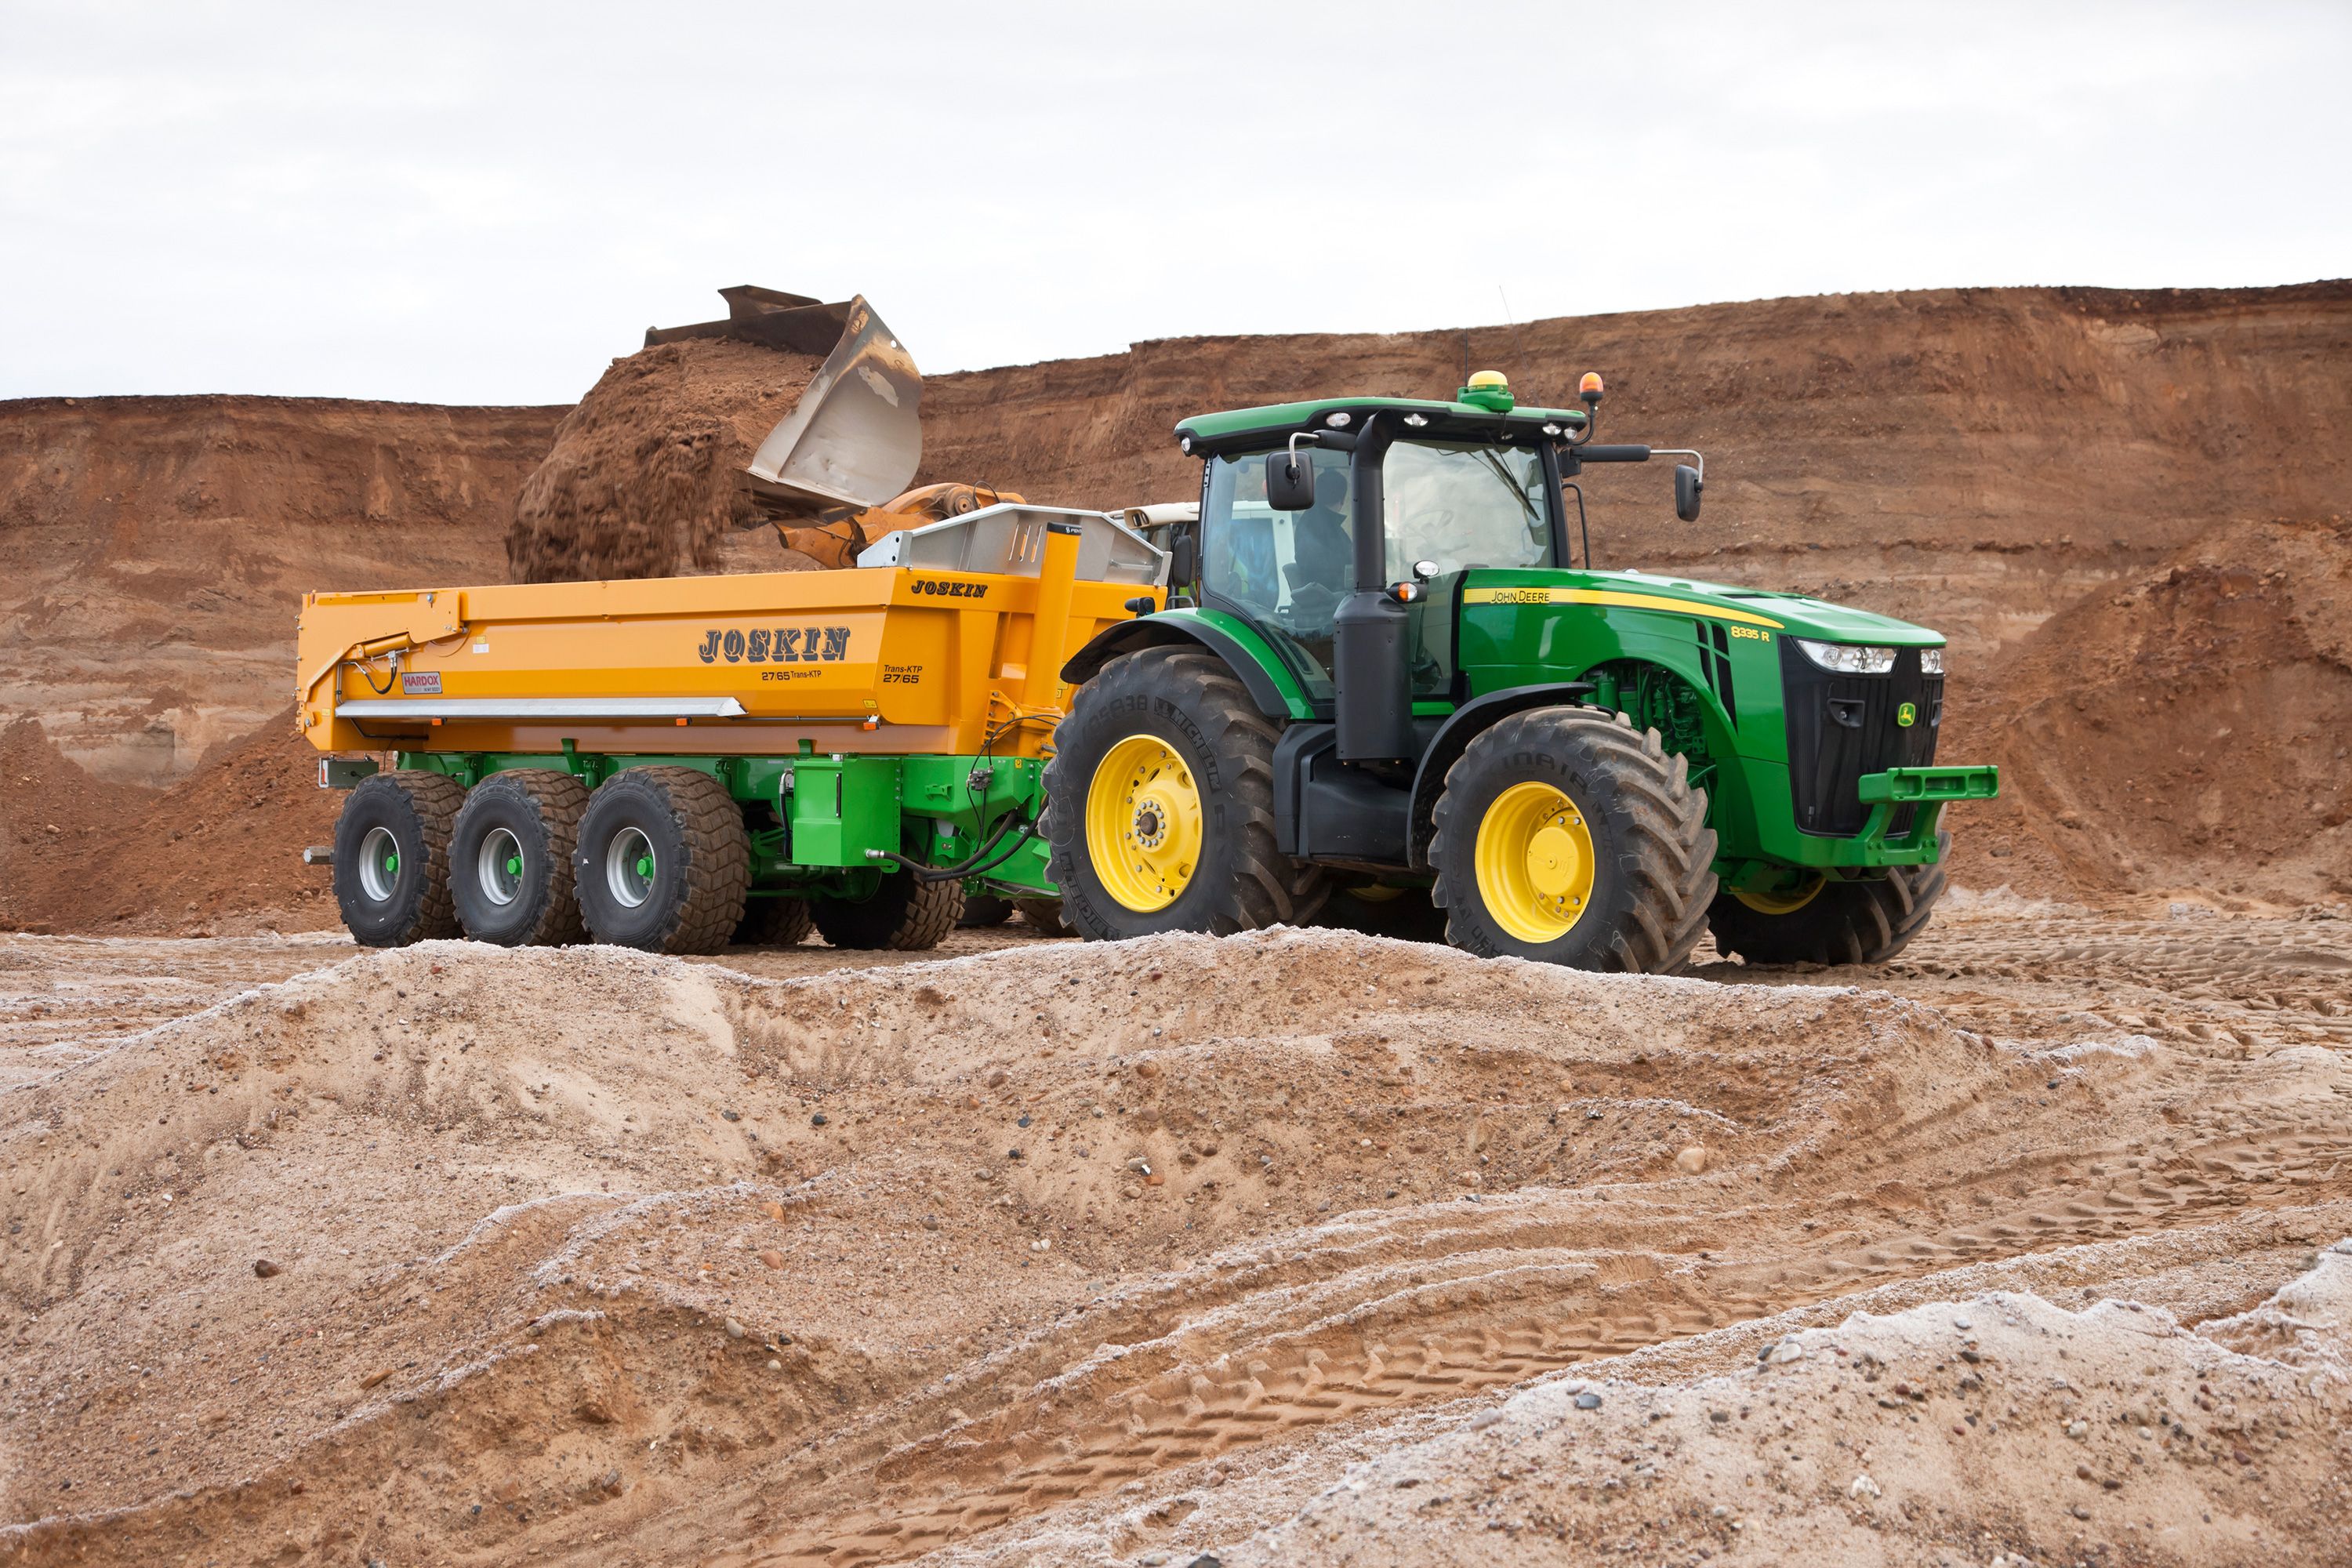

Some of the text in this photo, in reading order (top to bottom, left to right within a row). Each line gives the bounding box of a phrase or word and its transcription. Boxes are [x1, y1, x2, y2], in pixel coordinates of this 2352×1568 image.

[911, 580, 988, 598] JOSKIN
[1491, 590, 1550, 602] JOHN DEERE
[1731, 626, 1770, 642] 8335 R
[699, 626, 851, 664] JOSKIN
[884, 664, 923, 673] Trans-KTP
[404, 675, 439, 687] HARDOX
[1168, 706, 1223, 793] MICHELIN
